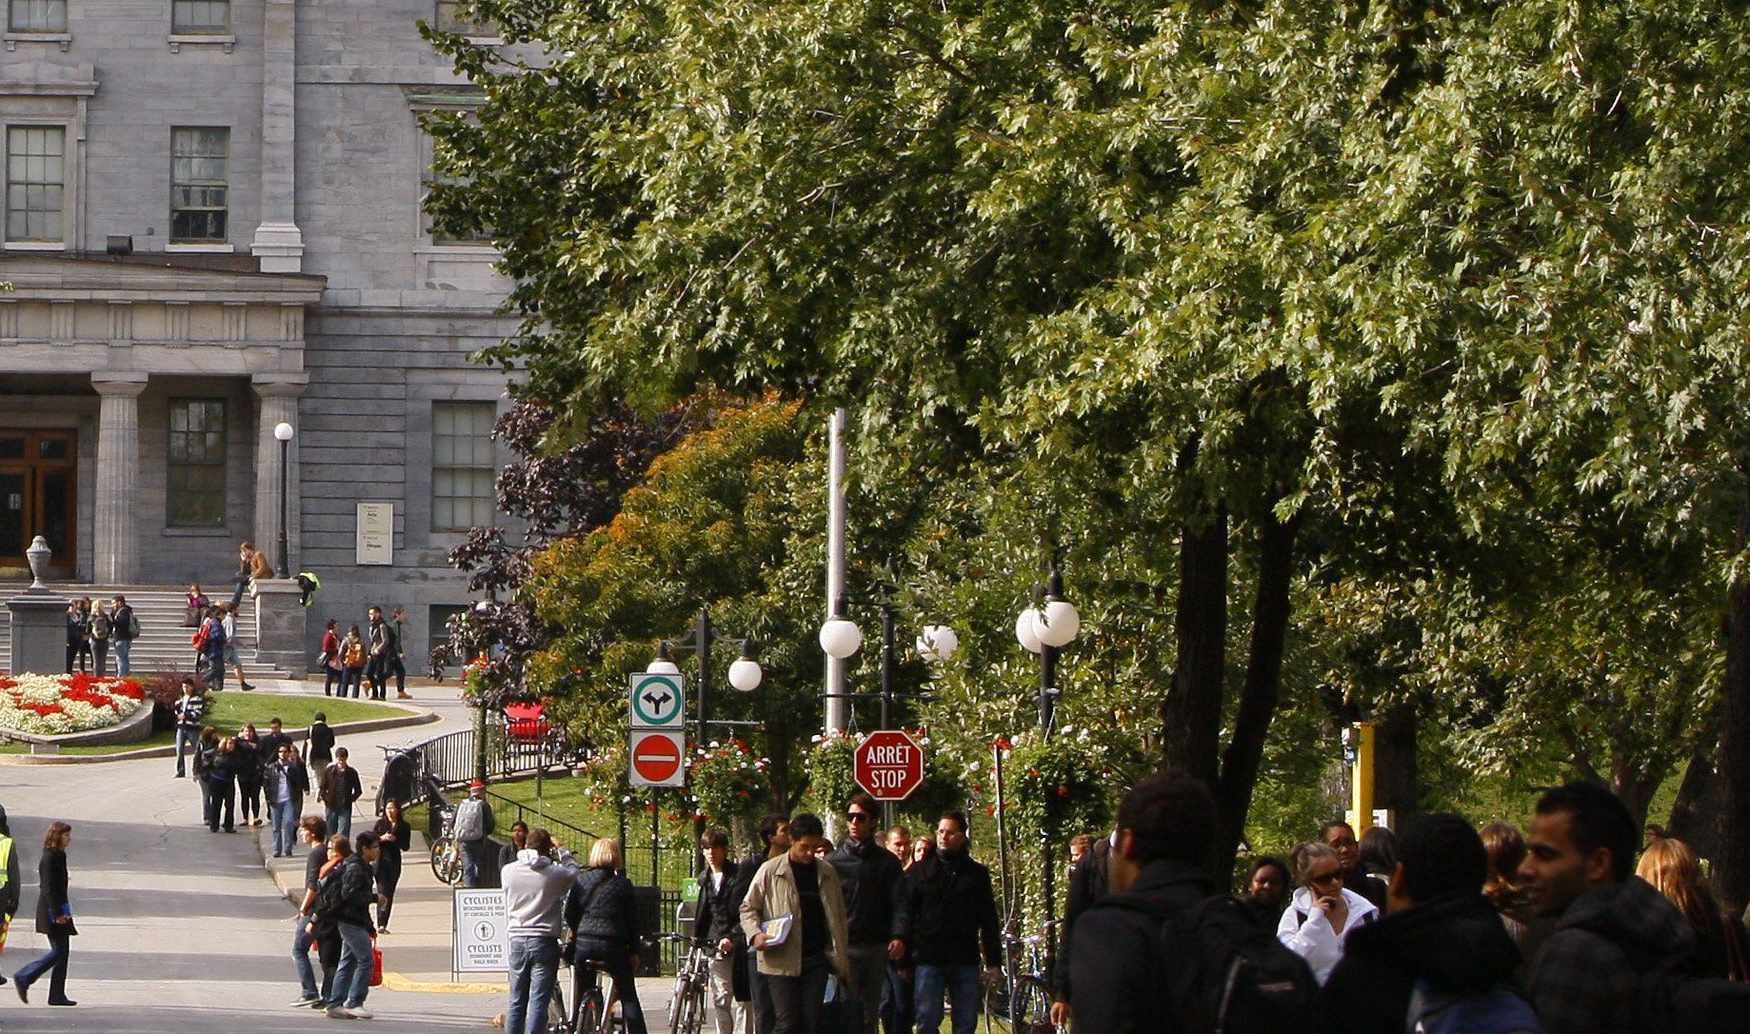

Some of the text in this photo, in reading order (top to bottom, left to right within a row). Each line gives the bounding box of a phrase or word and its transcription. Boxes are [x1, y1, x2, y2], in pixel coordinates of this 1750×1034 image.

[866, 742, 911, 764] ARRÊT
[871, 769, 907, 788] STOP
[463, 896, 503, 905] CYCLISTES
[467, 944, 503, 953] CYCLISTS
